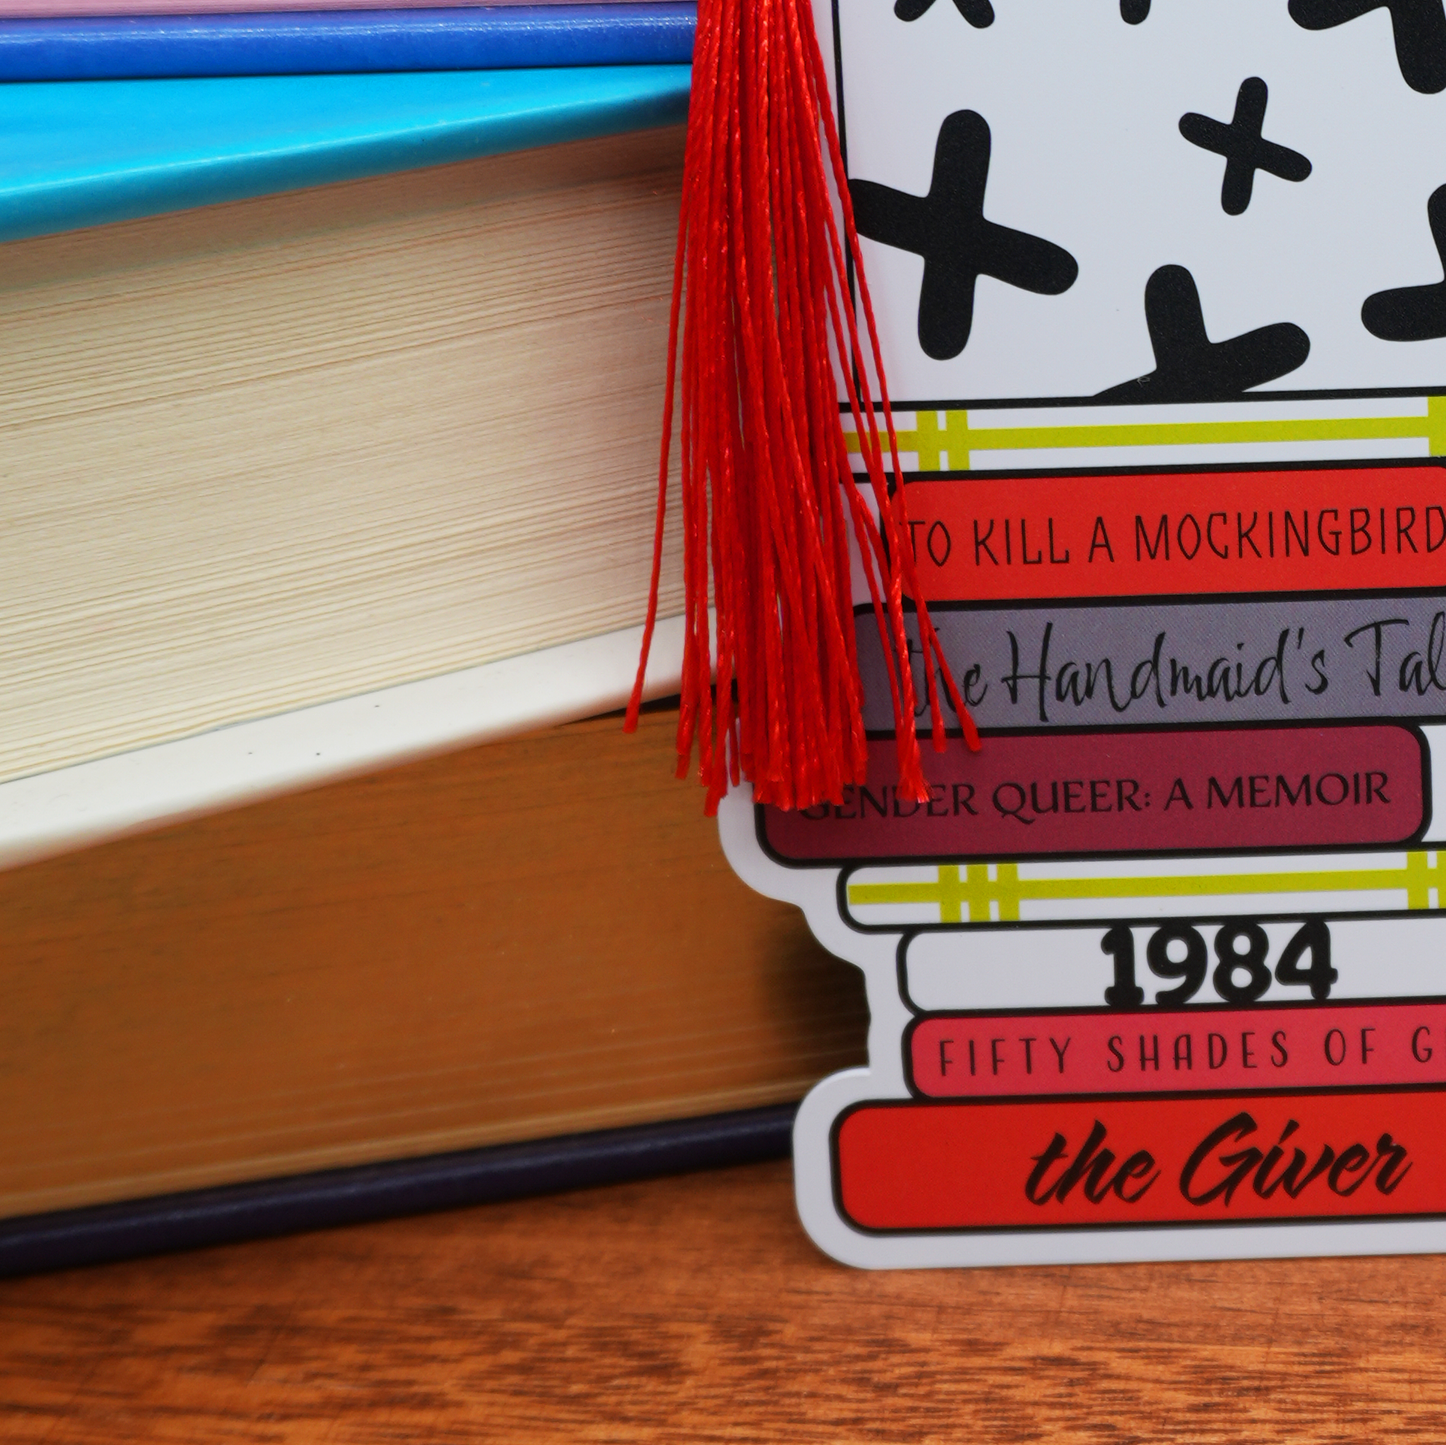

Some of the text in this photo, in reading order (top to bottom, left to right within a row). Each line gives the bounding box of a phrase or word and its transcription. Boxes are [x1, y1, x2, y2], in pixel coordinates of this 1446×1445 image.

[899, 520, 951, 567] TO
[973, 517, 1070, 566] KILL
[1088, 516, 1115, 563] A
[1001, 621, 1328, 723] Handmaid's
[991, 780, 1151, 825] QUEER:
[1164, 776, 1194, 812] A
[1207, 770, 1391, 810] MEMOIR
[1100, 917, 1338, 1007] 1984
[938, 1034, 1073, 1077] FIFTY
[1106, 1029, 1290, 1073] SHADES
[1325, 1027, 1377, 1066] OF
[1023, 1111, 1414, 1206] the Giver
